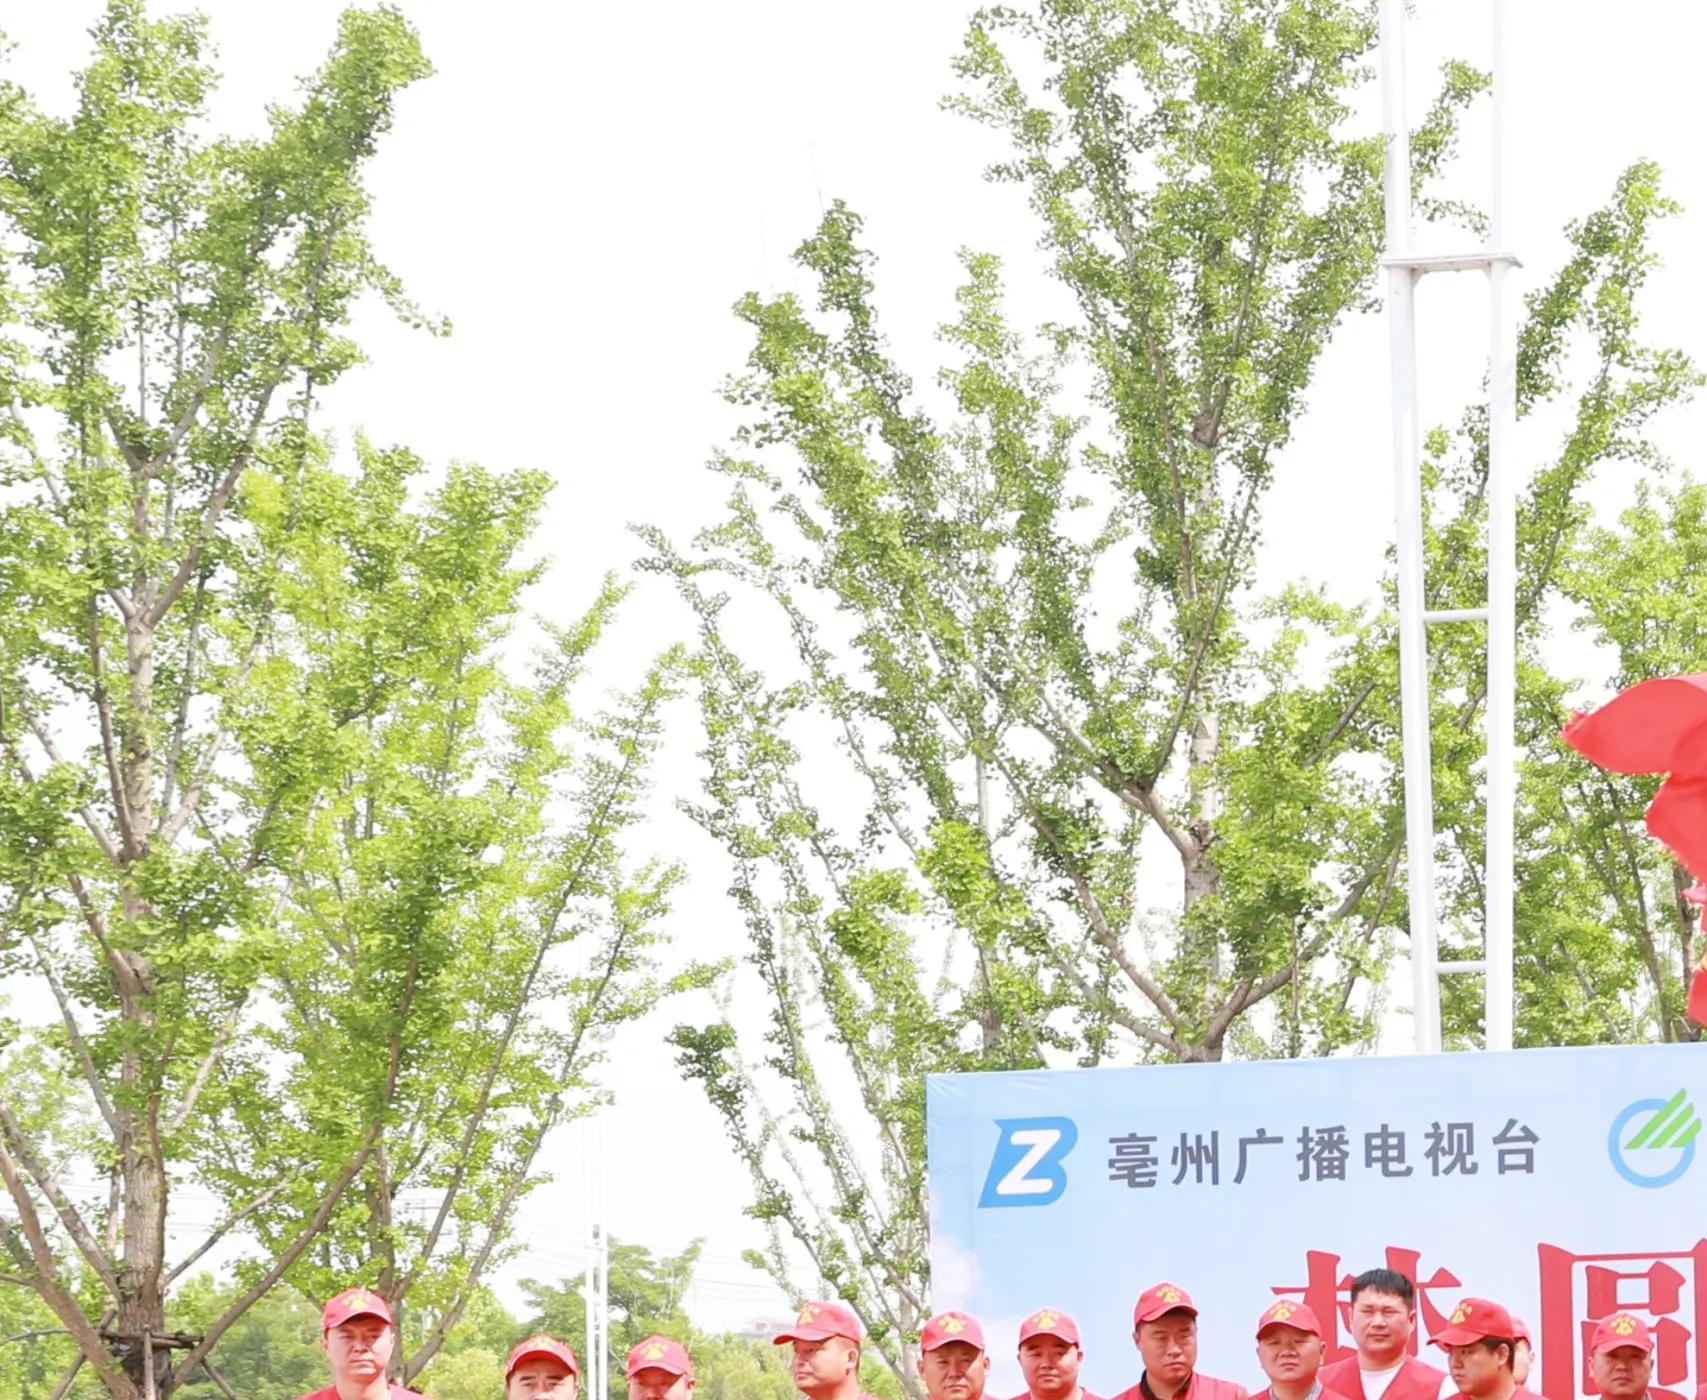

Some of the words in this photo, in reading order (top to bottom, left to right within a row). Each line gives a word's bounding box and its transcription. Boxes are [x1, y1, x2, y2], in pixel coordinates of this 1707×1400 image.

[1107, 1118, 1541, 1189] 亳州广播电视台
